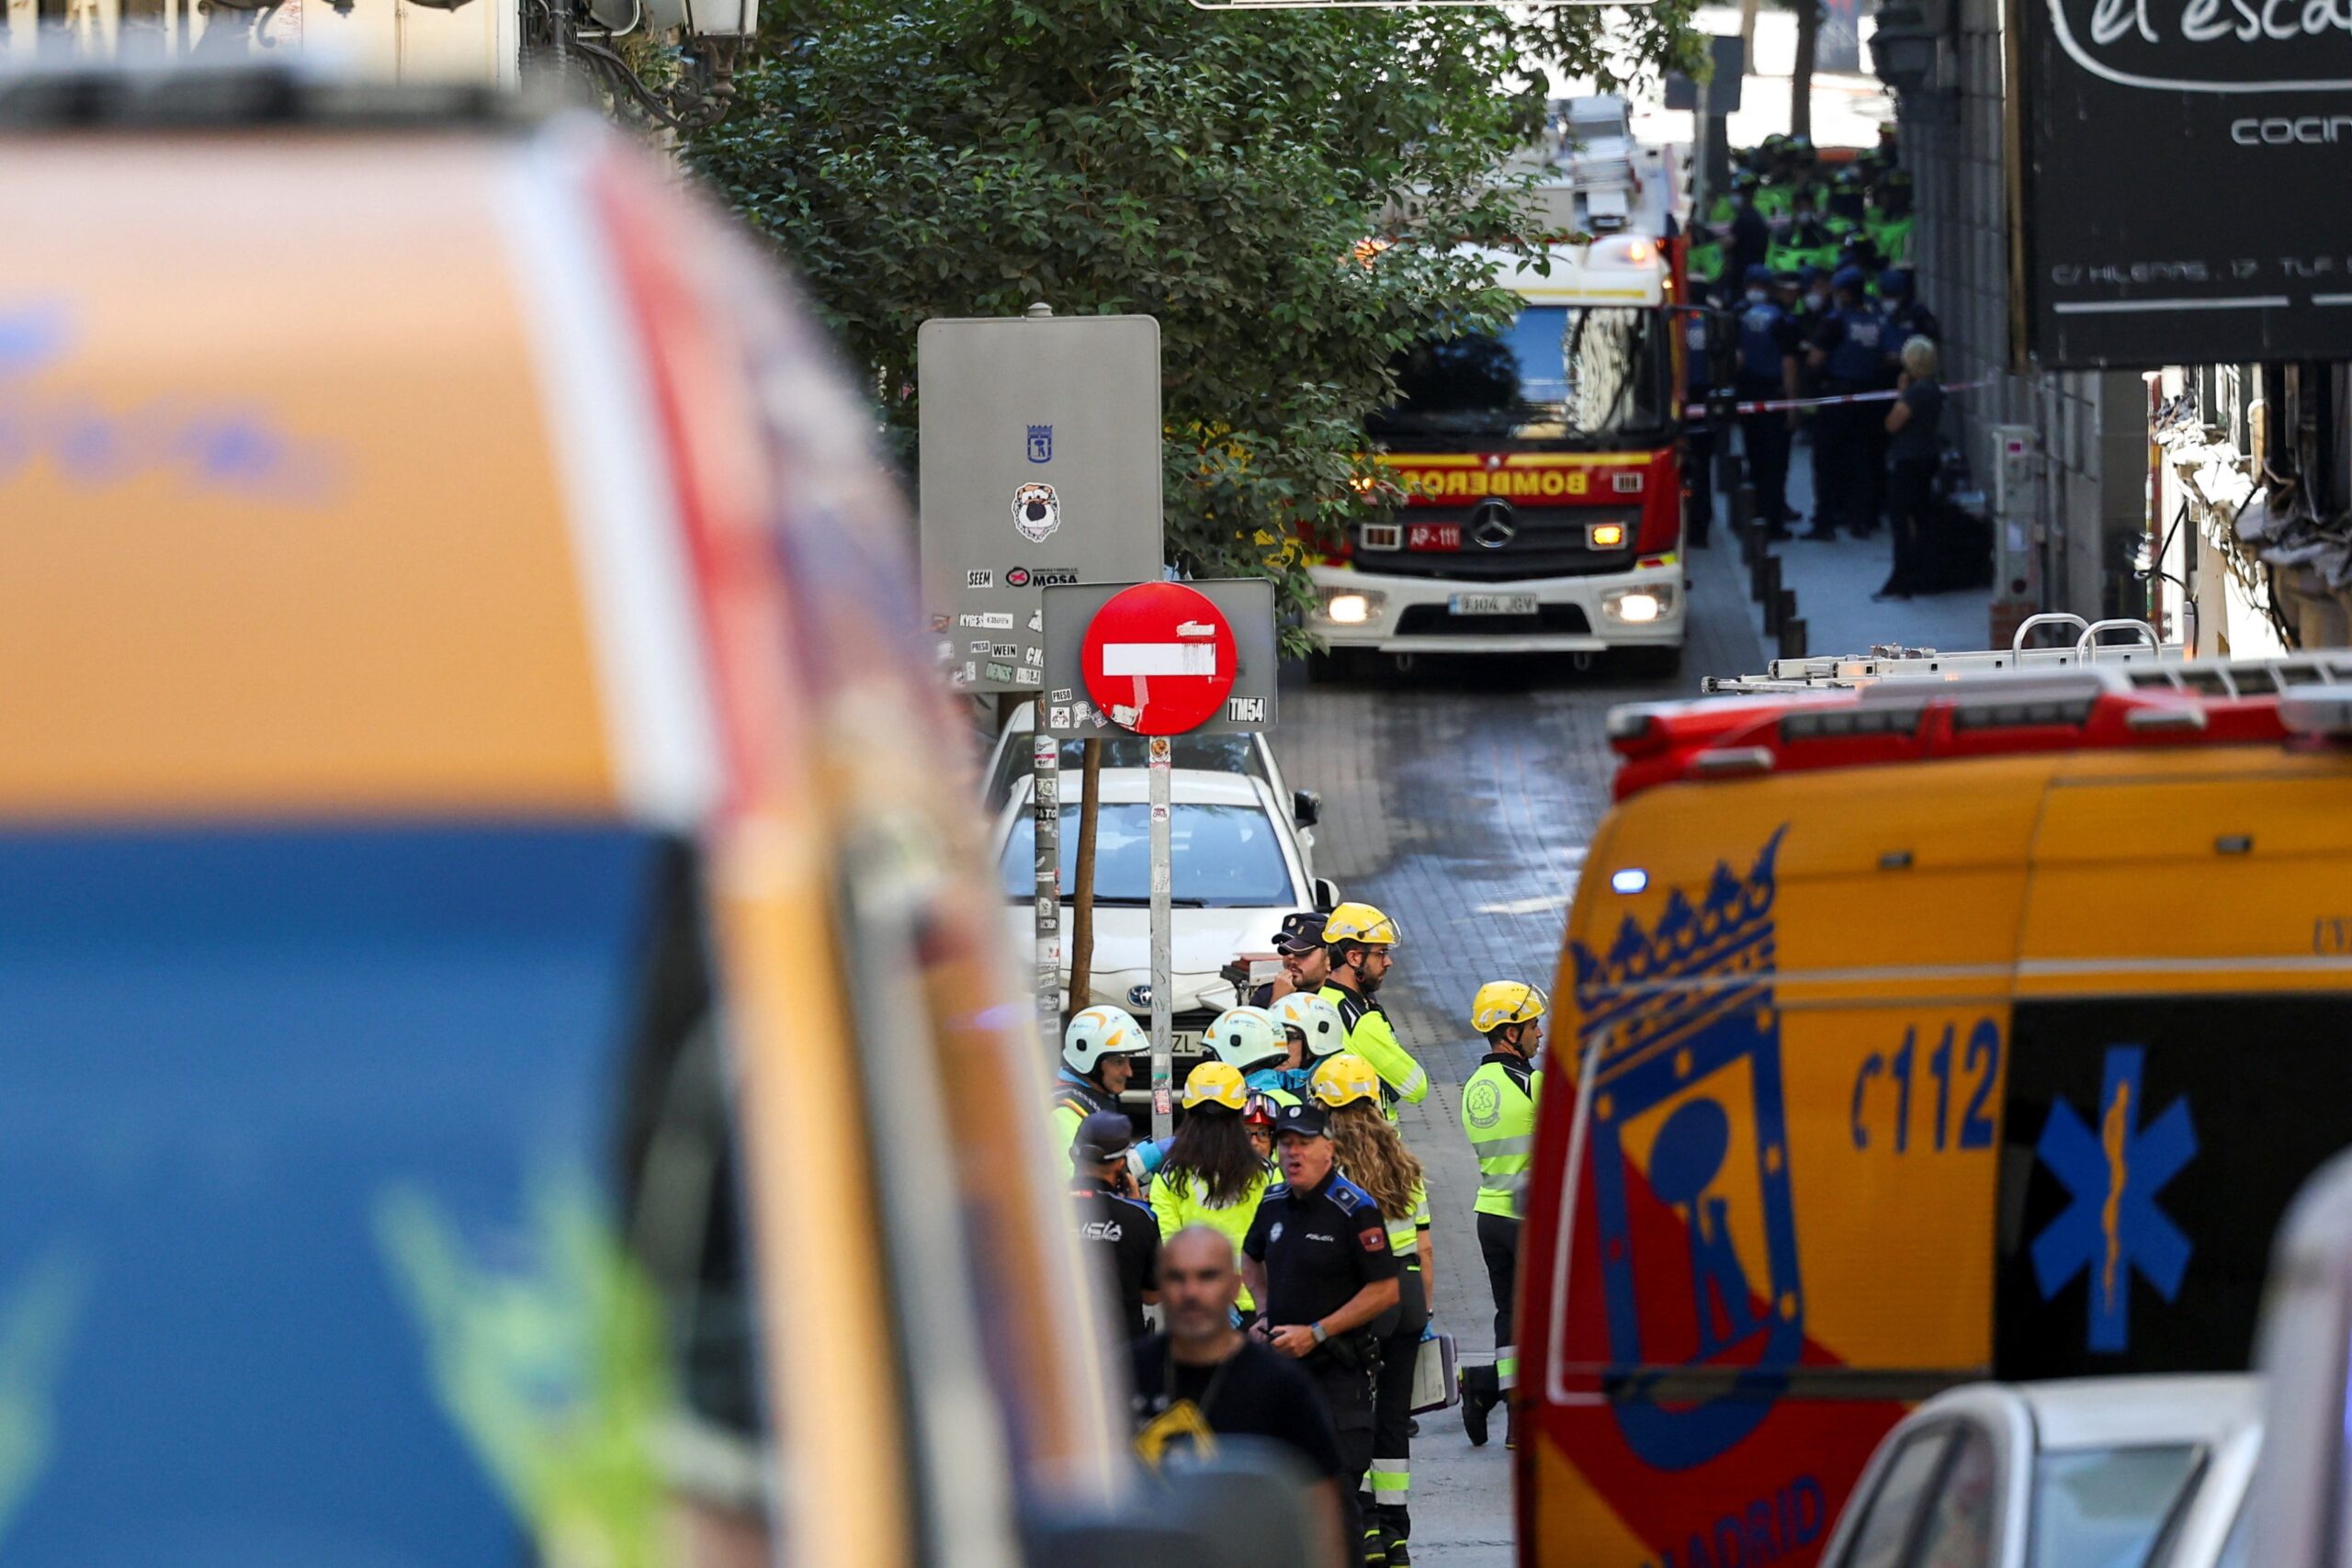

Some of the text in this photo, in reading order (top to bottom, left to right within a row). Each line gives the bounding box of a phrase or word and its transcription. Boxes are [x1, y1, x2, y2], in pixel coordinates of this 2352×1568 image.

[2180, 0, 2352, 42] esca
[968, 571, 991, 586] SEEM
[1033, 575, 1079, 586] MOSA
[993, 647, 1016, 655] WEIN
[1053, 690, 1070, 701] PRESO
[1230, 698, 1264, 722] TM54
[1892, 1019, 2000, 1153] 112
[1642, 1474, 1826, 1568] ADRID
